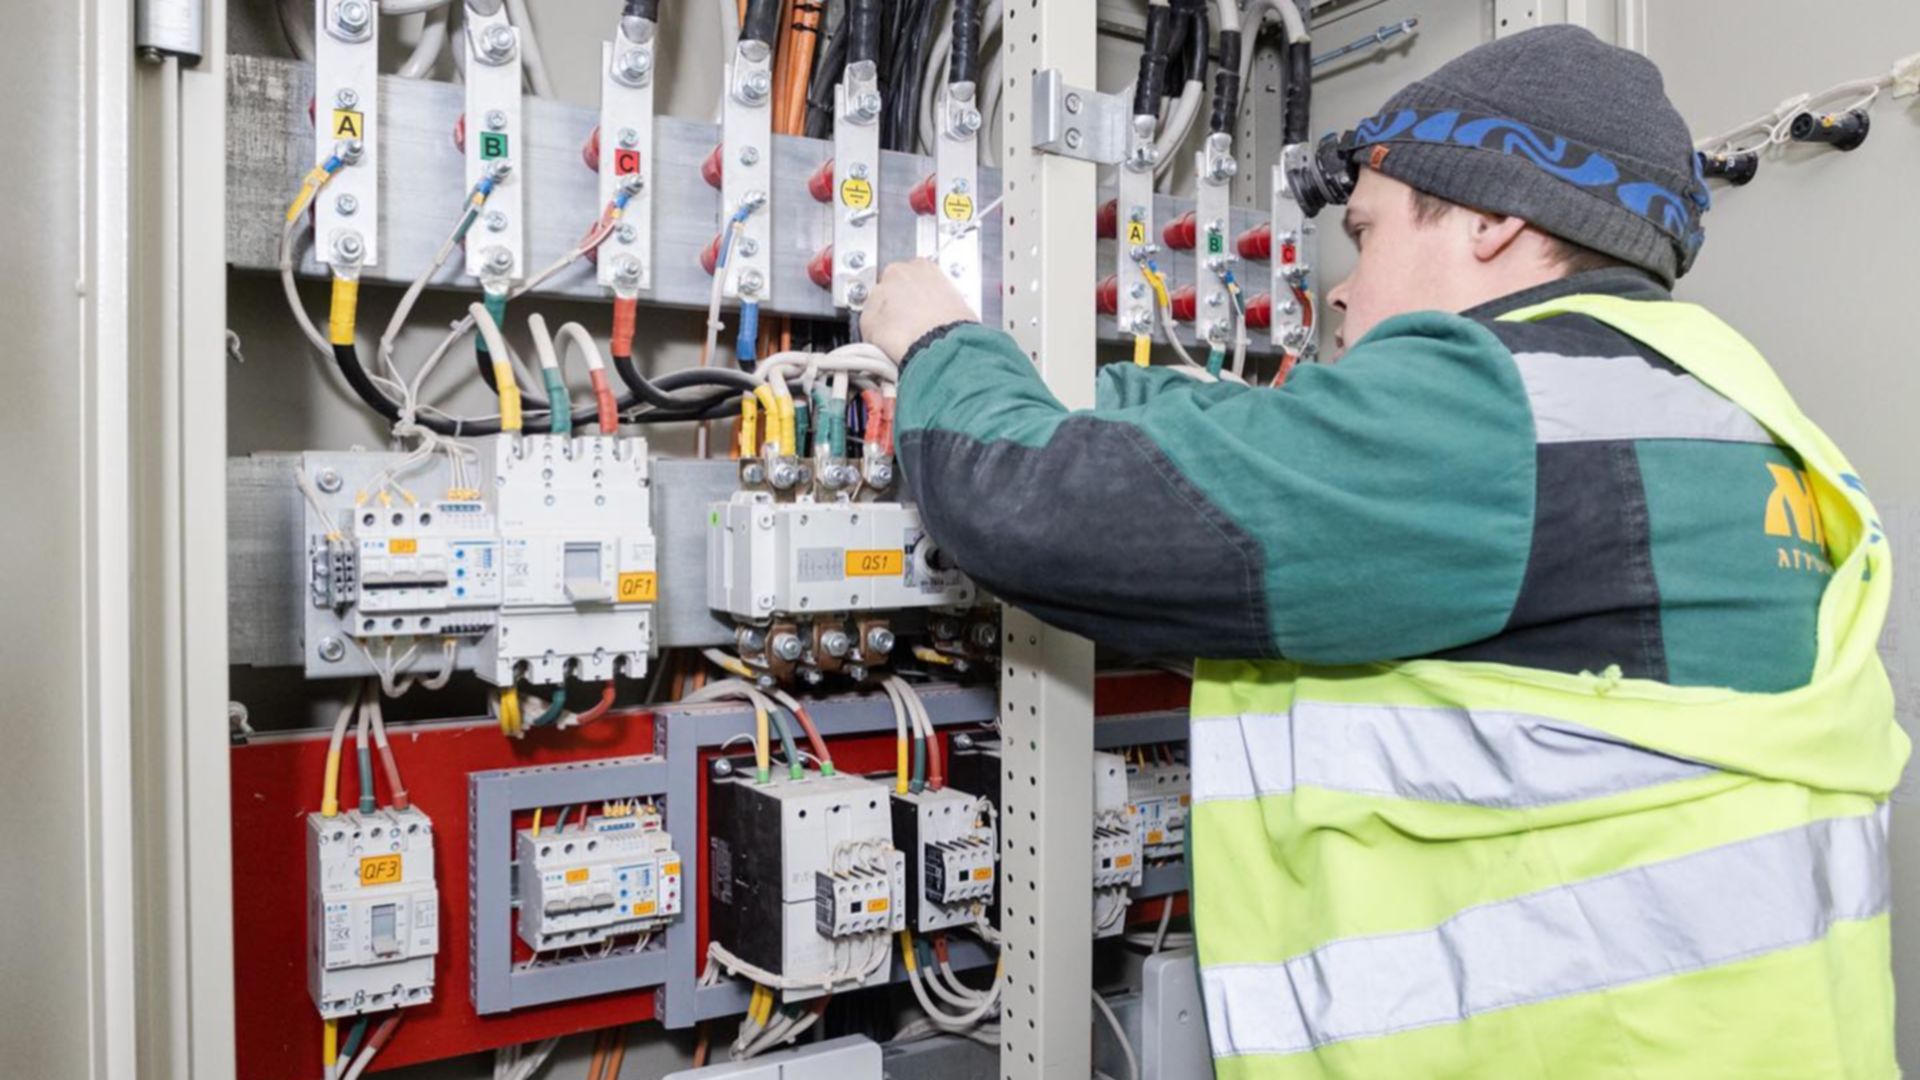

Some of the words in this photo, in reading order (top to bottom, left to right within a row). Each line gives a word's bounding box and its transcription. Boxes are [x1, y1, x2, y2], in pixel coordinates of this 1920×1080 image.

[337, 116, 356, 136] A
[485, 137, 501, 157] B
[619, 154, 634, 174] C
[1130, 227, 1142, 240] A
[1209, 238, 1220, 252] B
[1283, 248, 1293, 261] C
[862, 555, 888, 571] QS1
[622, 578, 652, 596] QF1
[364, 861, 398, 880] QF3
